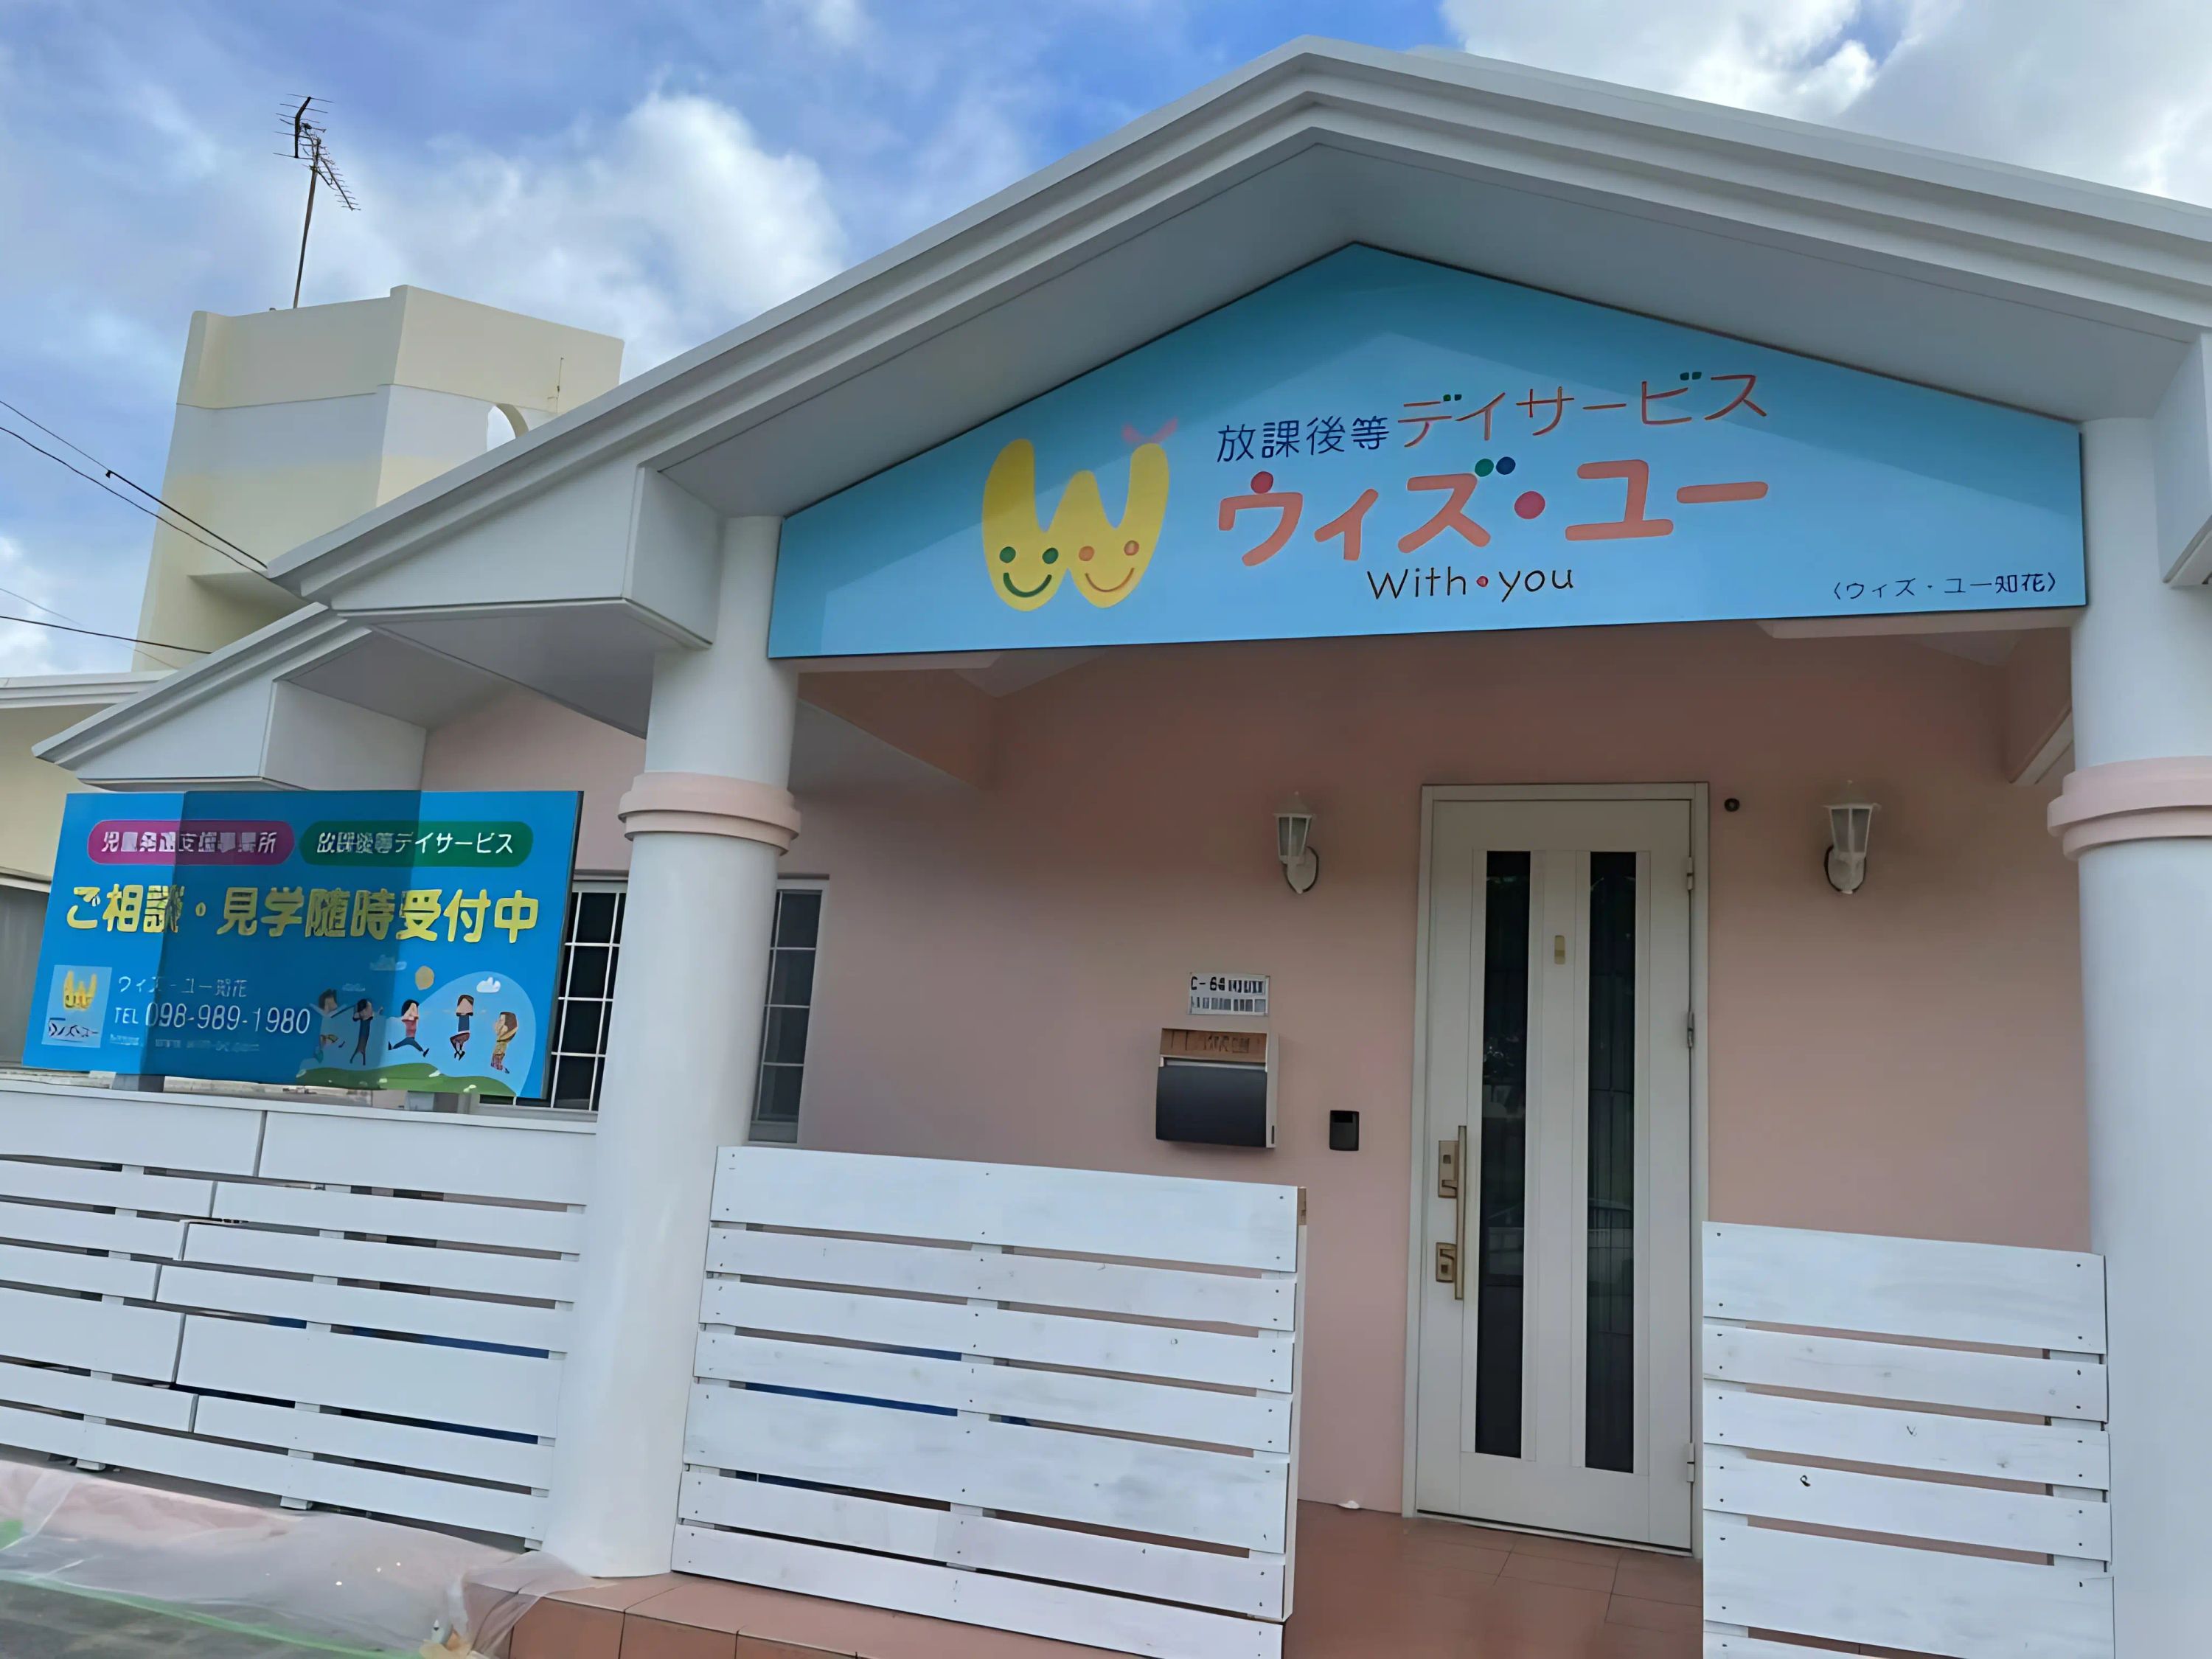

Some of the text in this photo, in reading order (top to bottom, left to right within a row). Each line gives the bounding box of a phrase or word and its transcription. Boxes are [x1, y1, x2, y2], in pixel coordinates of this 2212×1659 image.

[1218, 456, 1768, 566] ウィズ・ユー
[114, 1002, 311, 1034] TEL 098-989-1980
